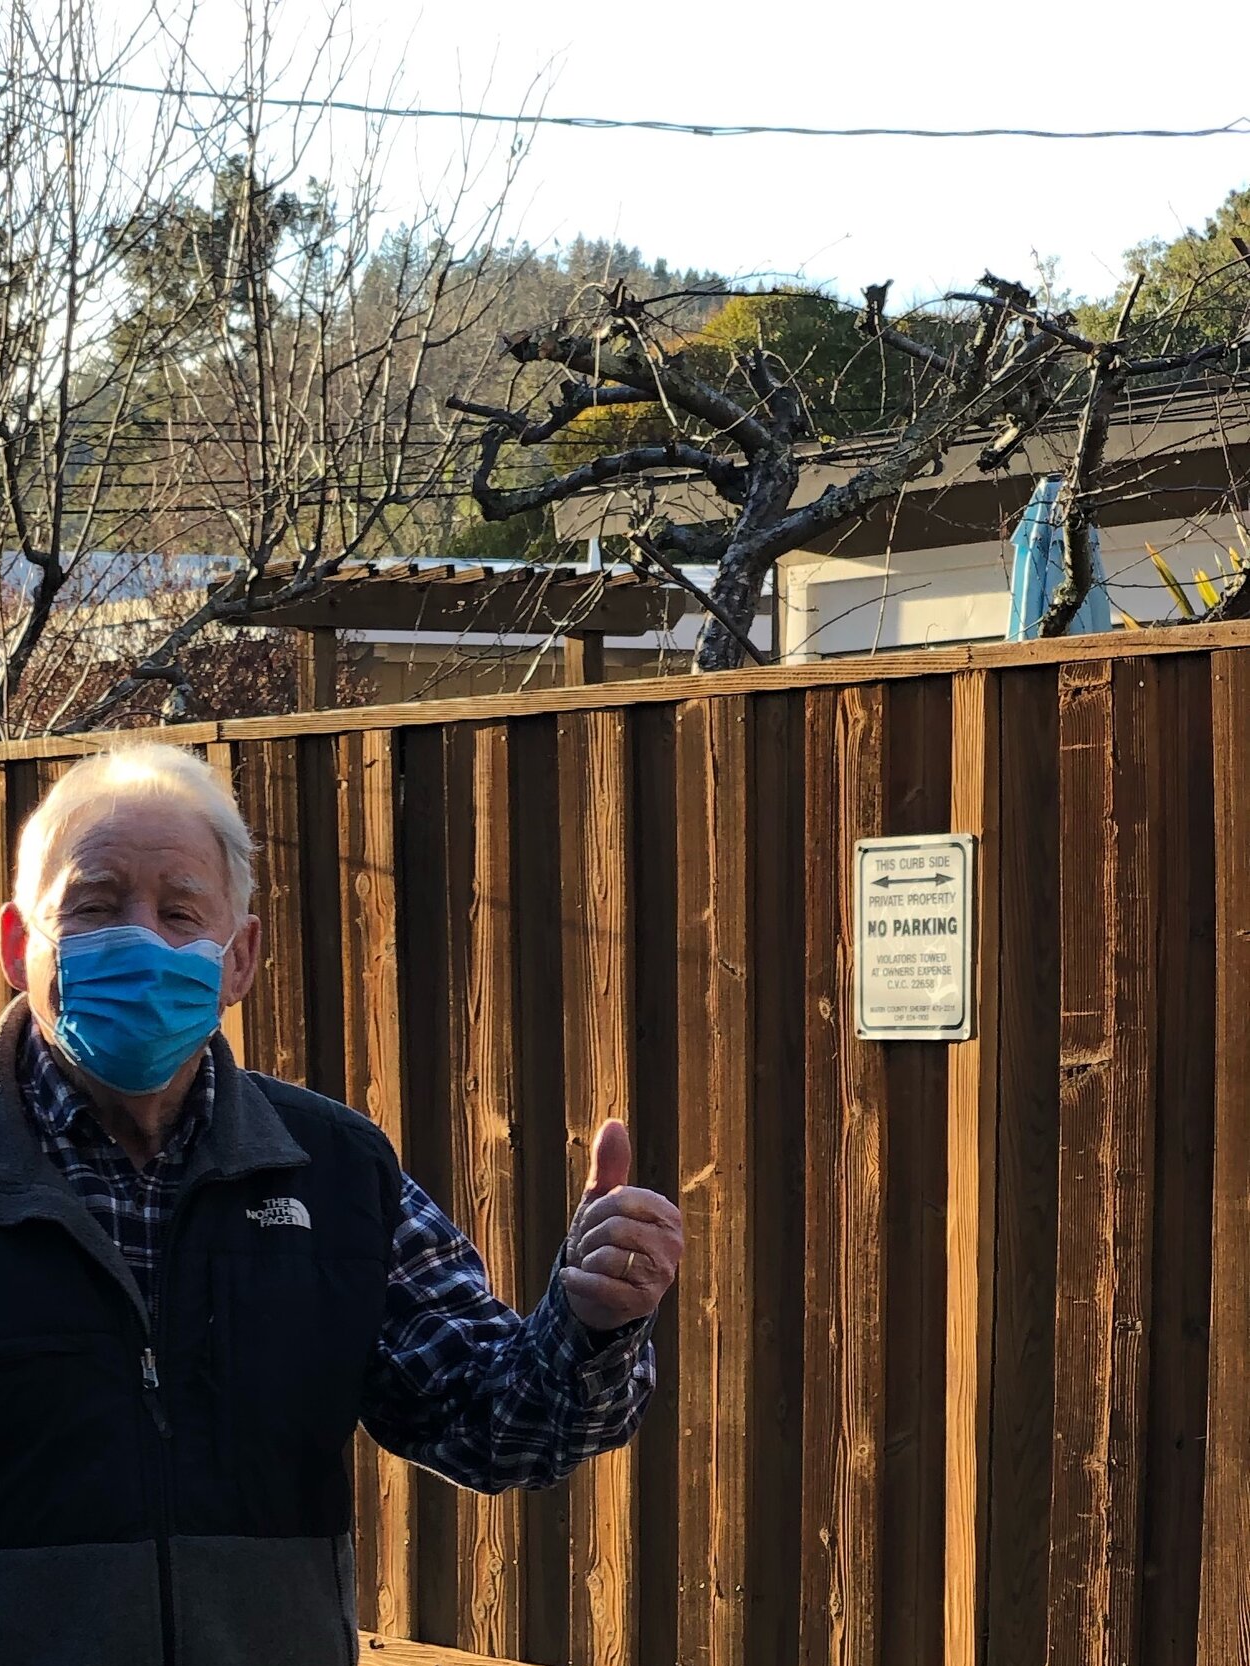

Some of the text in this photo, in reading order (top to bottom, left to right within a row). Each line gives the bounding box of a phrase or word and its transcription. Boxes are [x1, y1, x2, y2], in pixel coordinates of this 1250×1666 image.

[875, 856, 950, 871] THIS CURB SIDE
[869, 892, 956, 908] PRIVATE PROPERTY
[867, 916, 958, 938] NO PARKING
[877, 953, 947, 965] VIOLATORS TOWED
[871, 965, 952, 977] AT OWNERS EXPENSE
[911, 978, 935, 989] 22658
[262, 1197, 290, 1208] THE
[245, 1206, 291, 1220] NORTH
[260, 1215, 293, 1228] FACE
